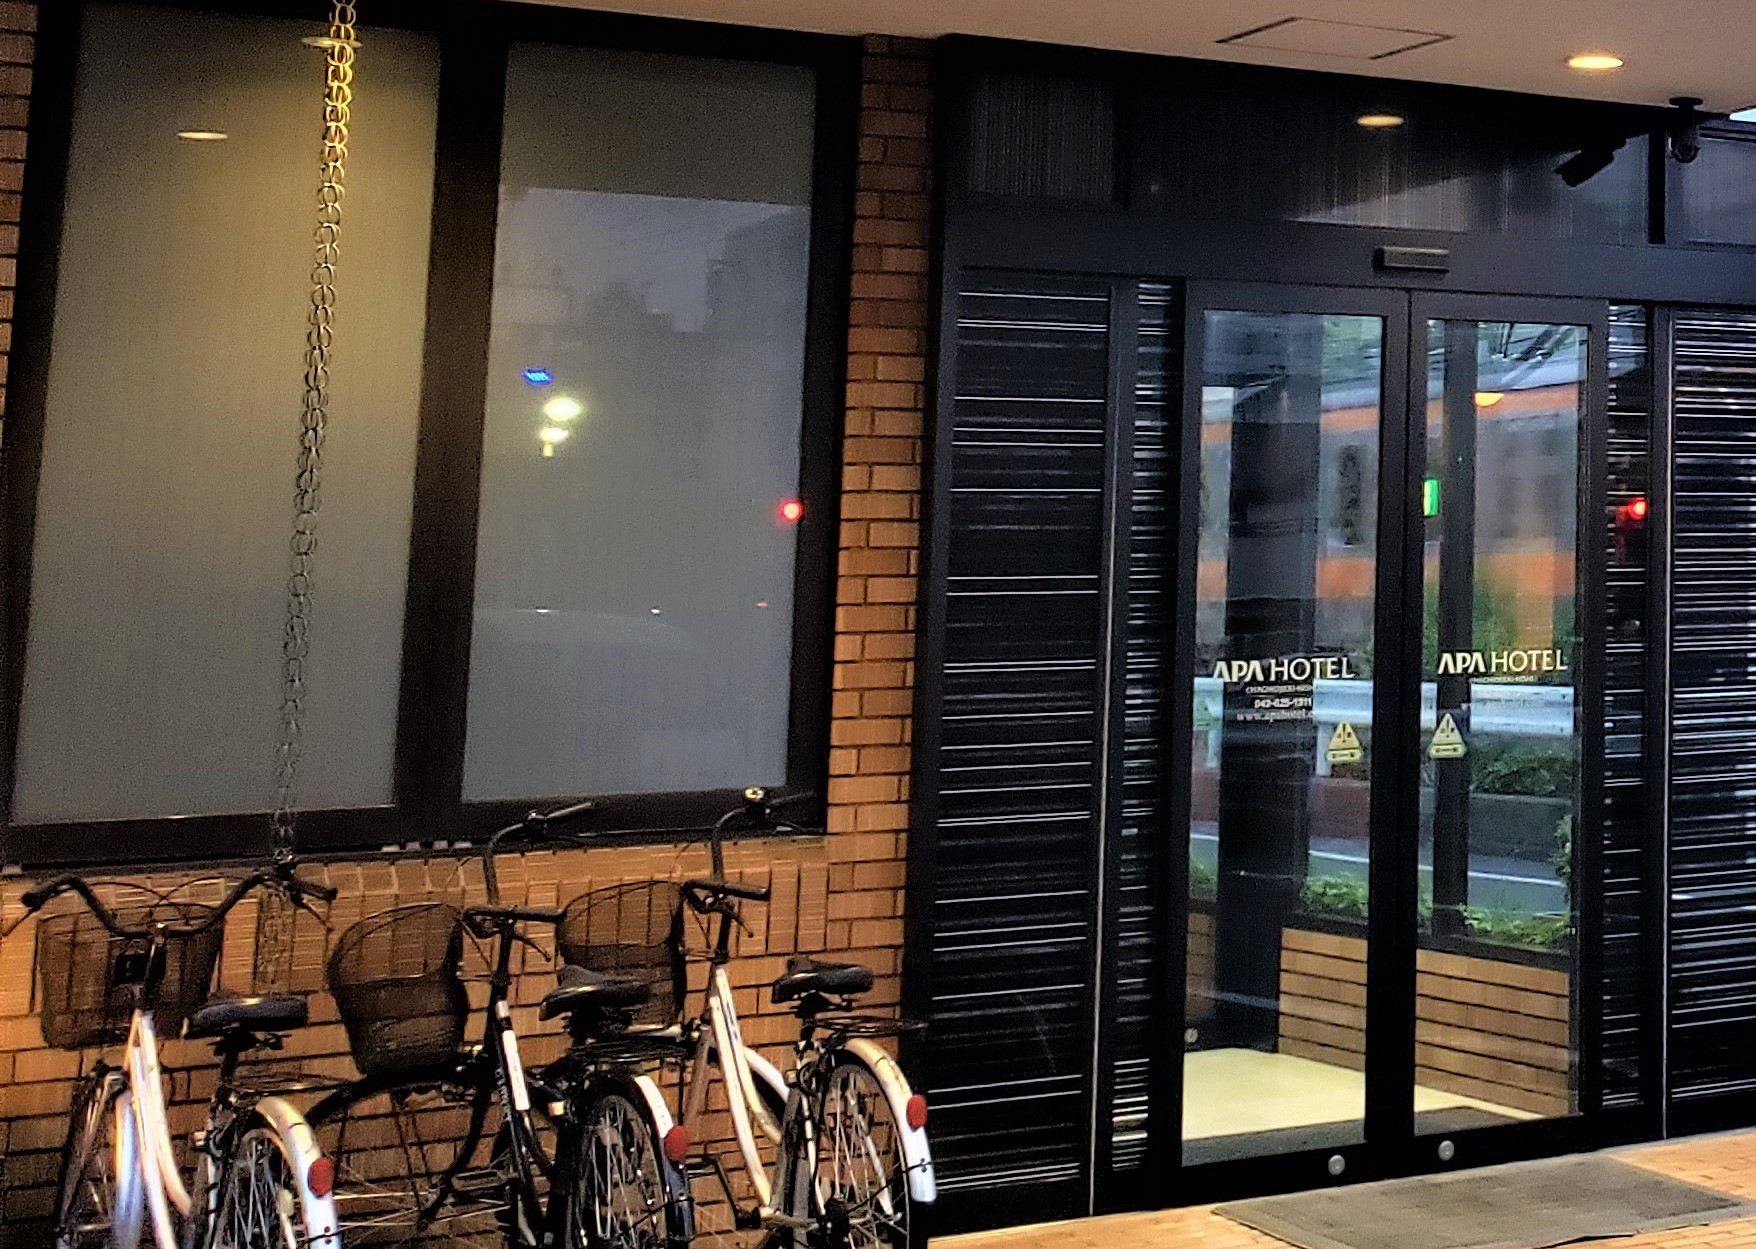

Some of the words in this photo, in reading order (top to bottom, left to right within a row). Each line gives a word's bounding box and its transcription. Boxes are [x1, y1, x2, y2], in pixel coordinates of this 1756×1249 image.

[1212, 660, 1265, 683] APA
[1269, 656, 1355, 681] HOTEL
[1437, 651, 1487, 675] APA
[1490, 649, 1569, 673] HOTEL
